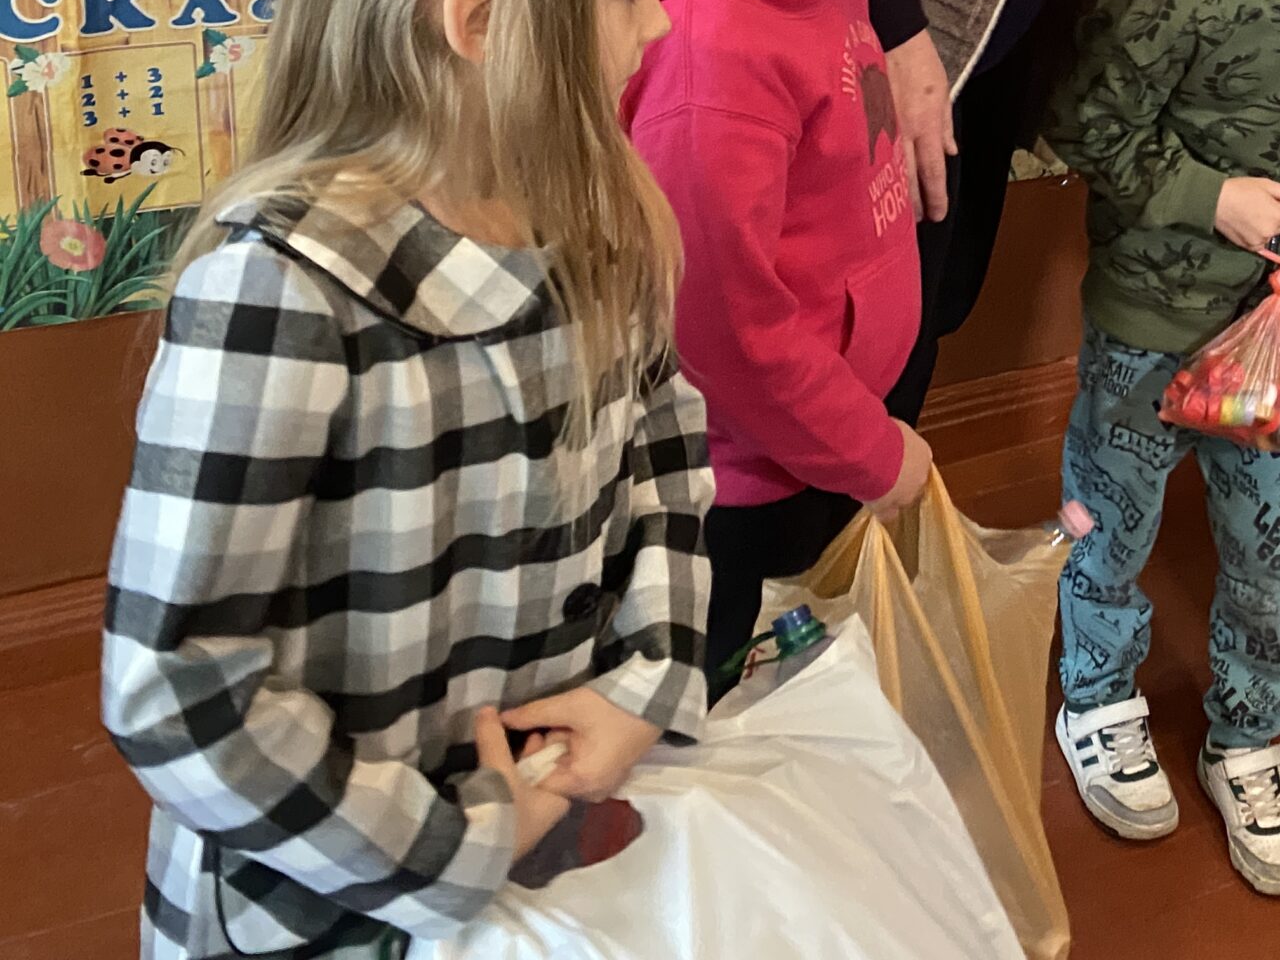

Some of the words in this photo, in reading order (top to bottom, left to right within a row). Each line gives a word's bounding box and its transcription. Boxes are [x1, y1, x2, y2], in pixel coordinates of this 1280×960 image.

[147, 68, 162, 83] 3
[82, 93, 96, 107] 2
[150, 86, 164, 99] 2
[83, 111, 98, 127] 3
[152, 103, 165, 116] 1
